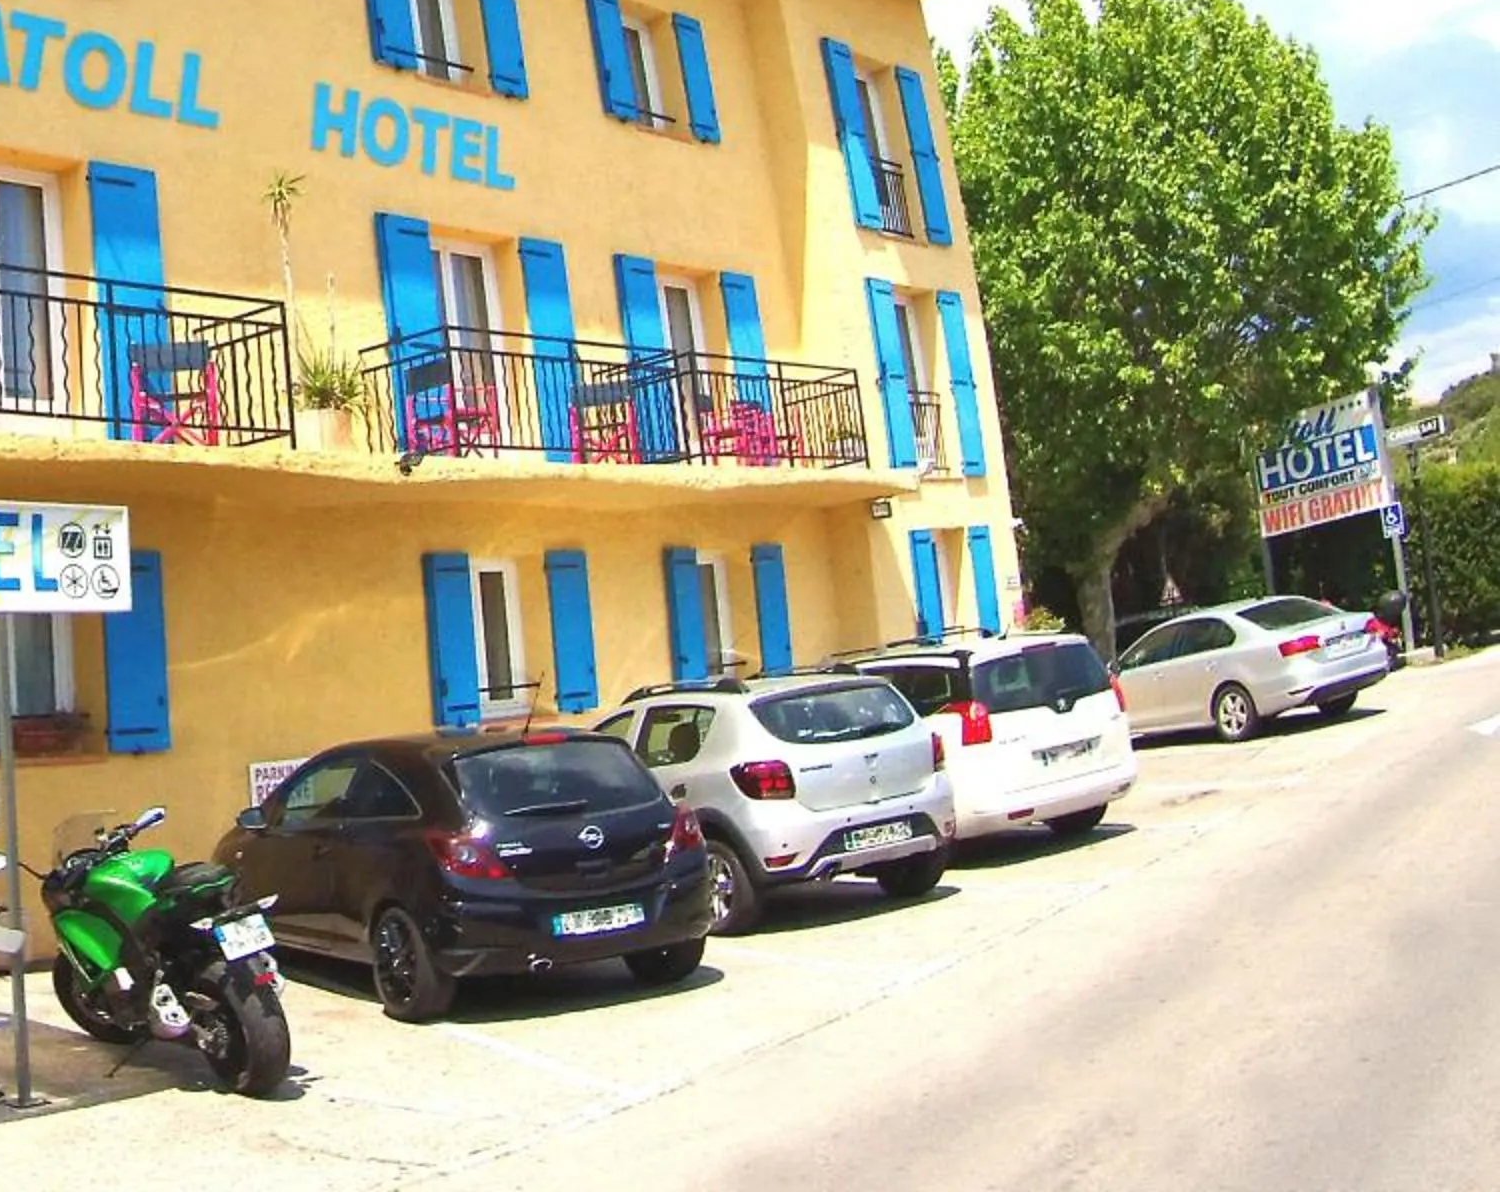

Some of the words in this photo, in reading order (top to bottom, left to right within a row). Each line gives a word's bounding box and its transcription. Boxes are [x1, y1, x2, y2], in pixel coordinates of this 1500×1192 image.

[310, 81, 516, 190] HOTEL
[1259, 427, 1375, 488] HOTEL
[1299, 470, 1356, 495] CONFORT
[1264, 501, 1305, 533] WIFI
